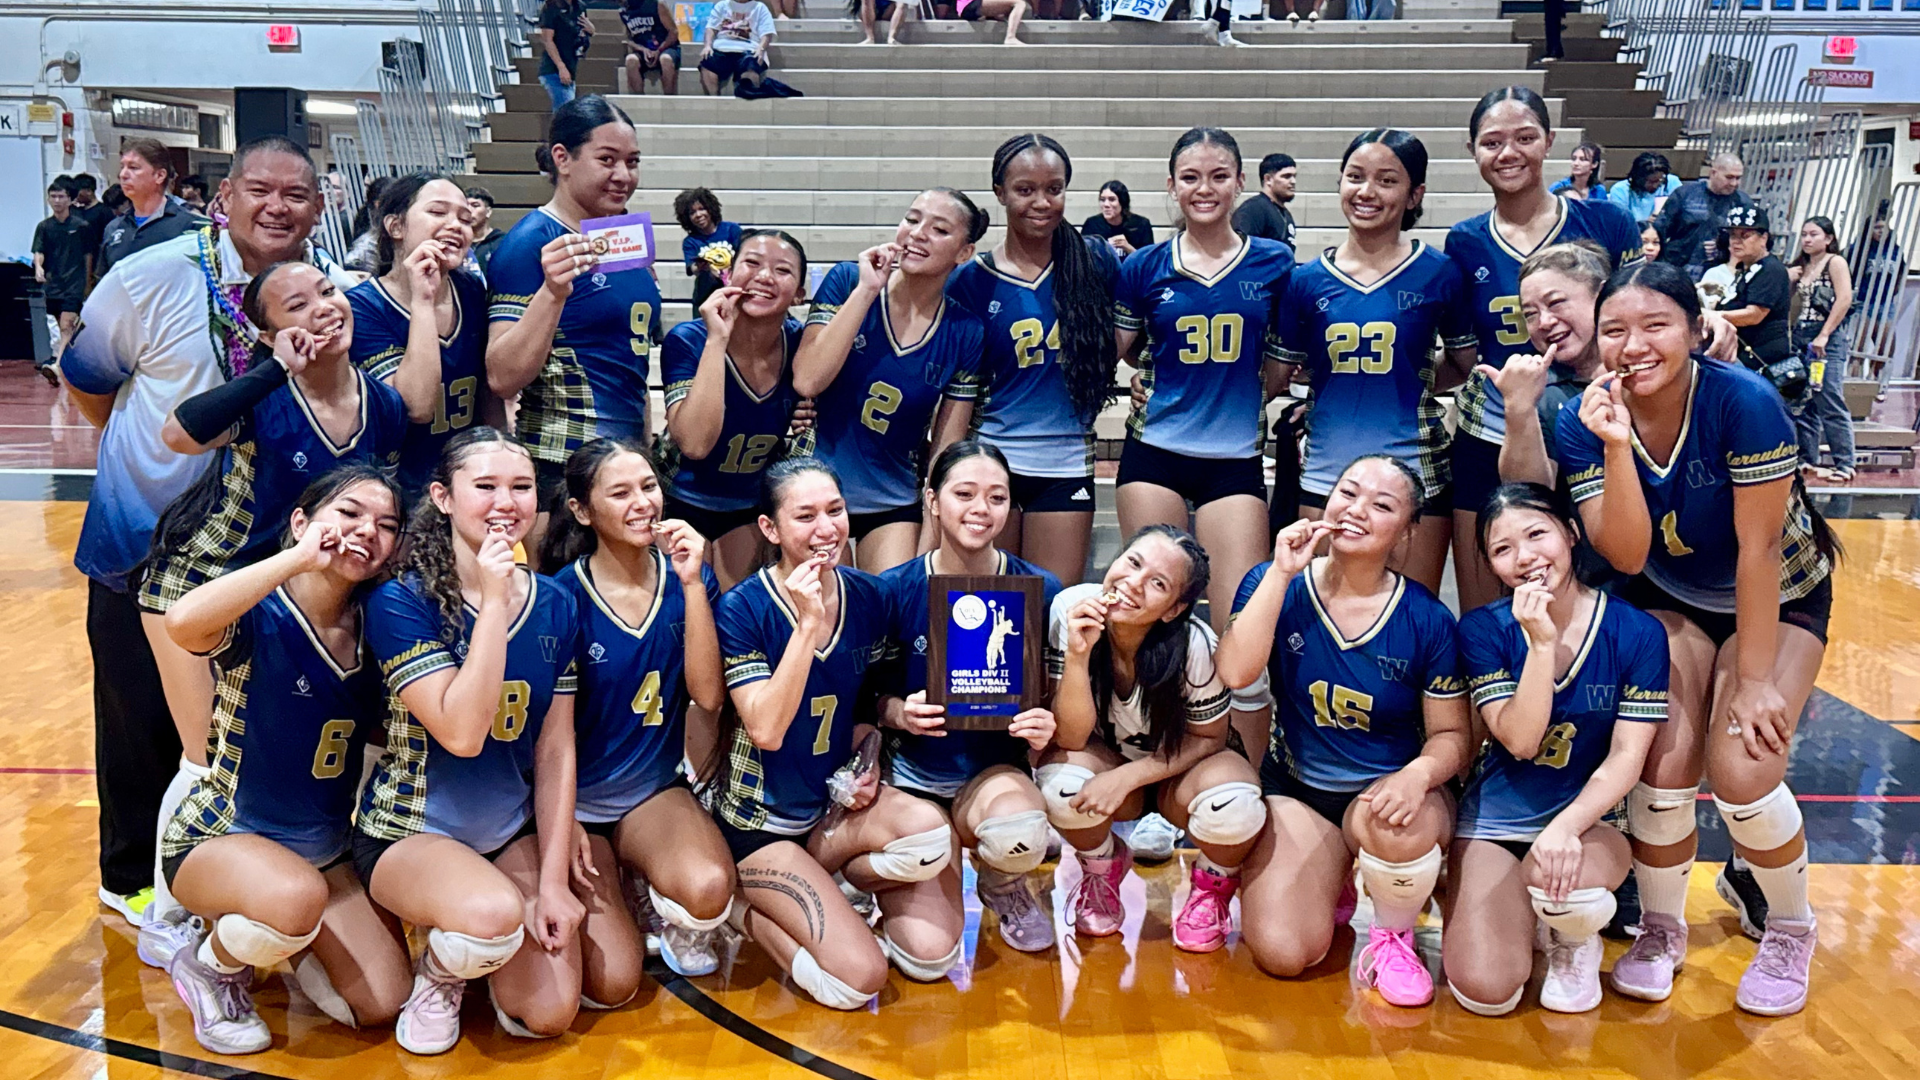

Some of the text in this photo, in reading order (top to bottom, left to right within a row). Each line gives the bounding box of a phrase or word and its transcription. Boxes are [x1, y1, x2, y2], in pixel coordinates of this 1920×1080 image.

[1828, 71, 1869, 81] SMOKING
[1, 115, 12, 130] K
[630, 302, 652, 355] 9
[1175, 313, 1244, 364] 30
[1325, 321, 1397, 374] 23
[431, 376, 477, 434] 13
[860, 380, 903, 435] 2
[718, 433, 778, 473] 12
[1660, 510, 1693, 556] 1
[378, 639, 445, 675] arauders
[951, 669, 1009, 677] GIRLS DIV II
[951, 678, 1011, 686] VOLLEYBALL
[490, 680, 531, 742] 8
[631, 670, 663, 726] 4
[1308, 680, 1373, 732] 15
[1586, 685, 1615, 711] W
[312, 719, 356, 779] 6
[810, 695, 838, 755] 7
